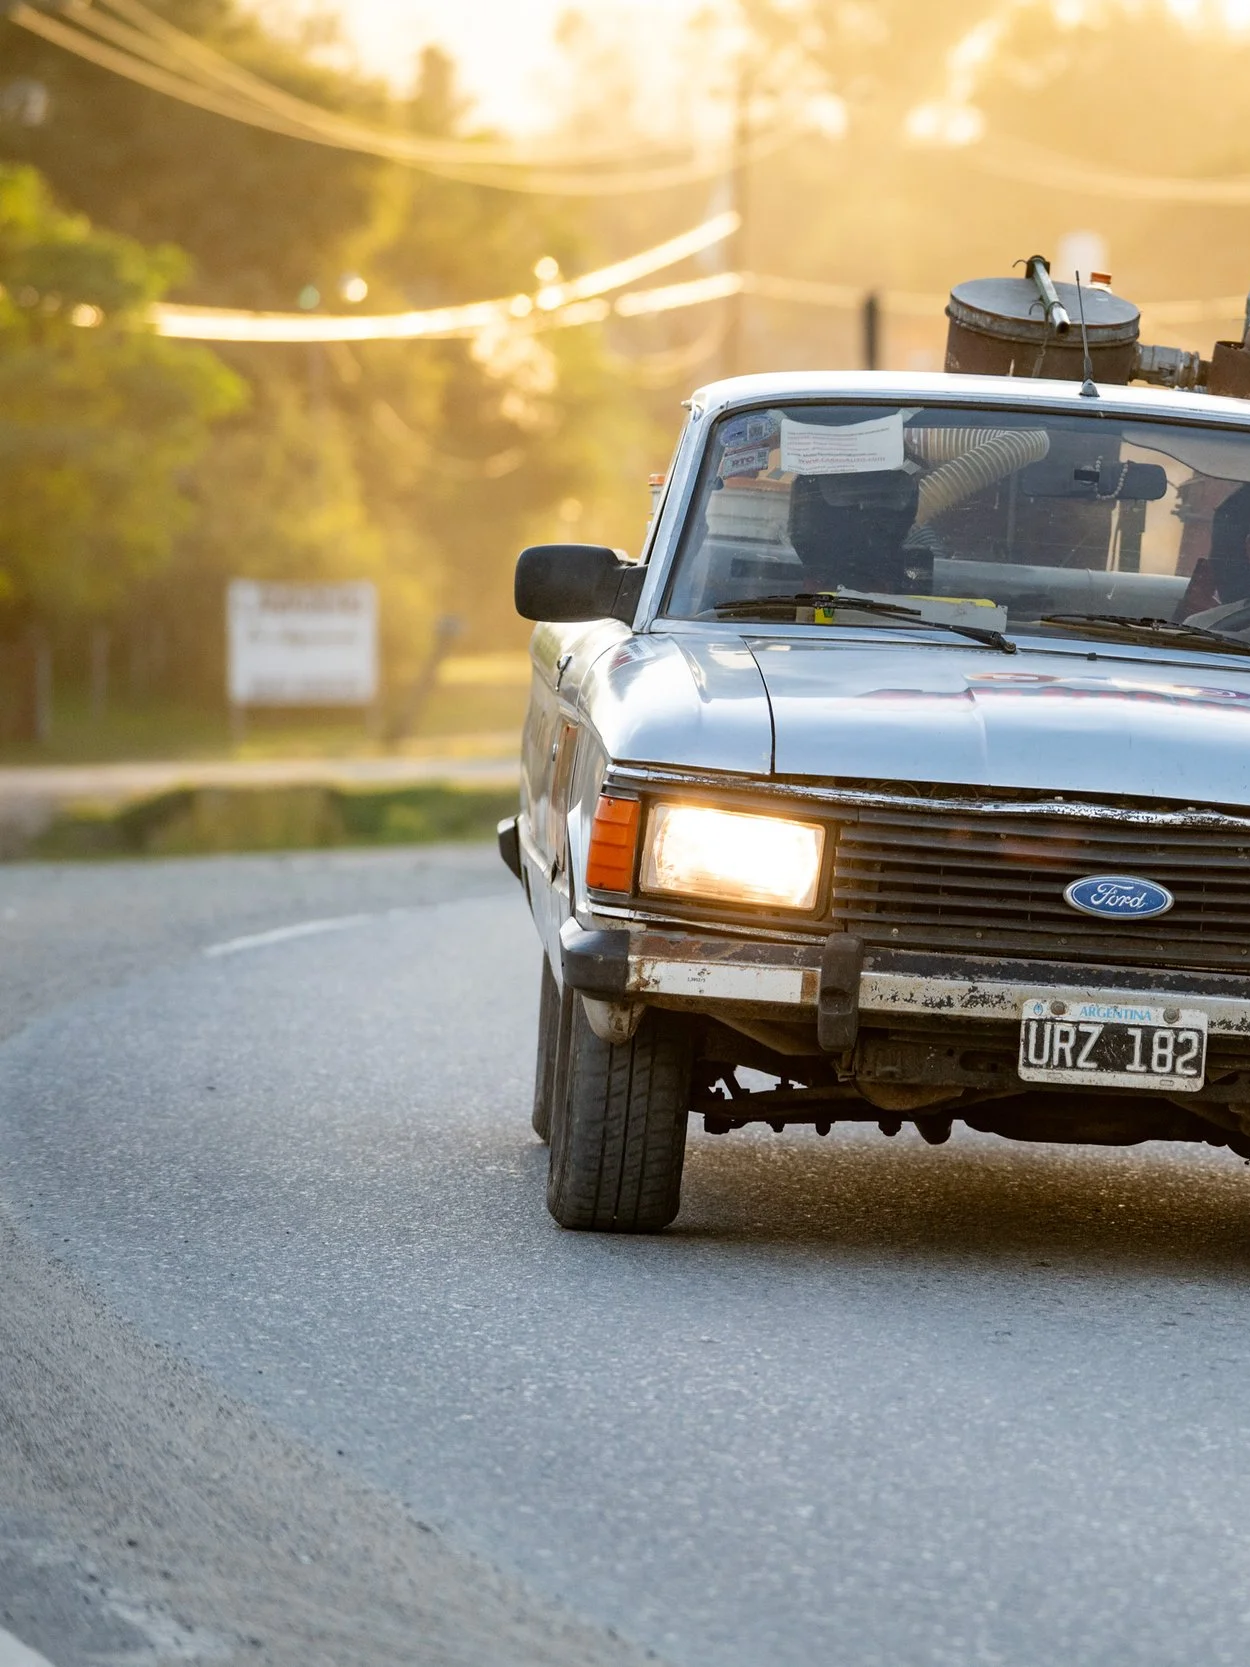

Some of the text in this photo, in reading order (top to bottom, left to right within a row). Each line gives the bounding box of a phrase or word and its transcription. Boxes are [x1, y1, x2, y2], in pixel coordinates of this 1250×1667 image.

[1090, 882, 1147, 909] Ford
[1079, 1005, 1152, 1022] ARGENTINA
[1028, 1019, 1199, 1076] URZ 182
